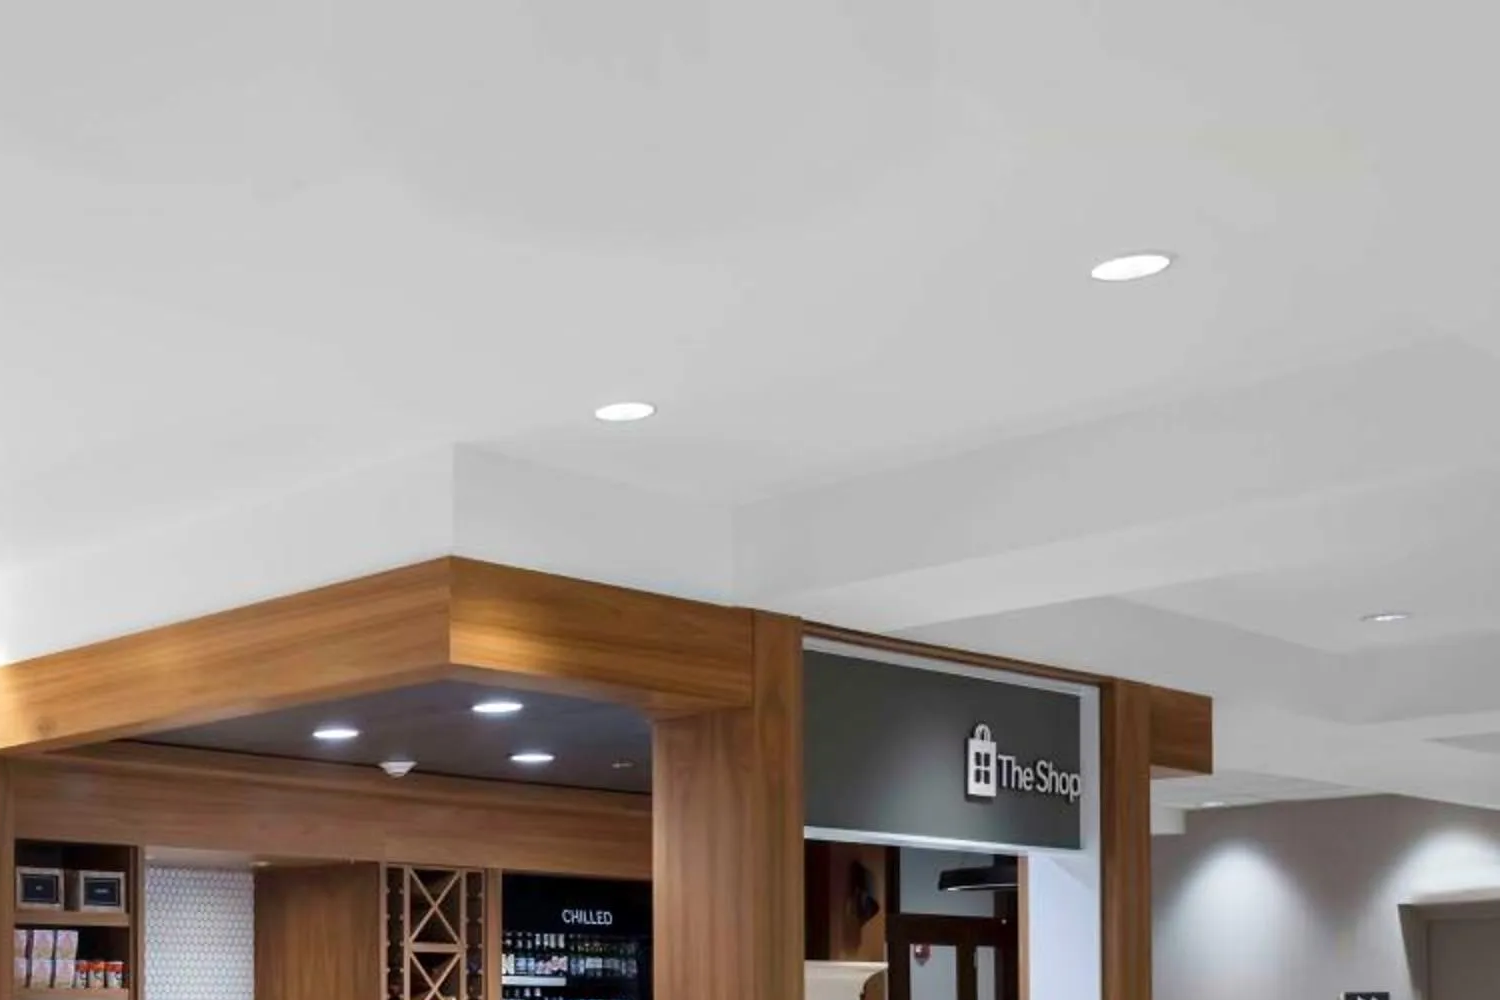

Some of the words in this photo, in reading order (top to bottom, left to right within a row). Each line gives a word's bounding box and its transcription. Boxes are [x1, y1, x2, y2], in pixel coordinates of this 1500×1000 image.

[998, 754, 1034, 791] The
[1036, 760, 1081, 803] Shop
[561, 909, 613, 925] CHILLED
